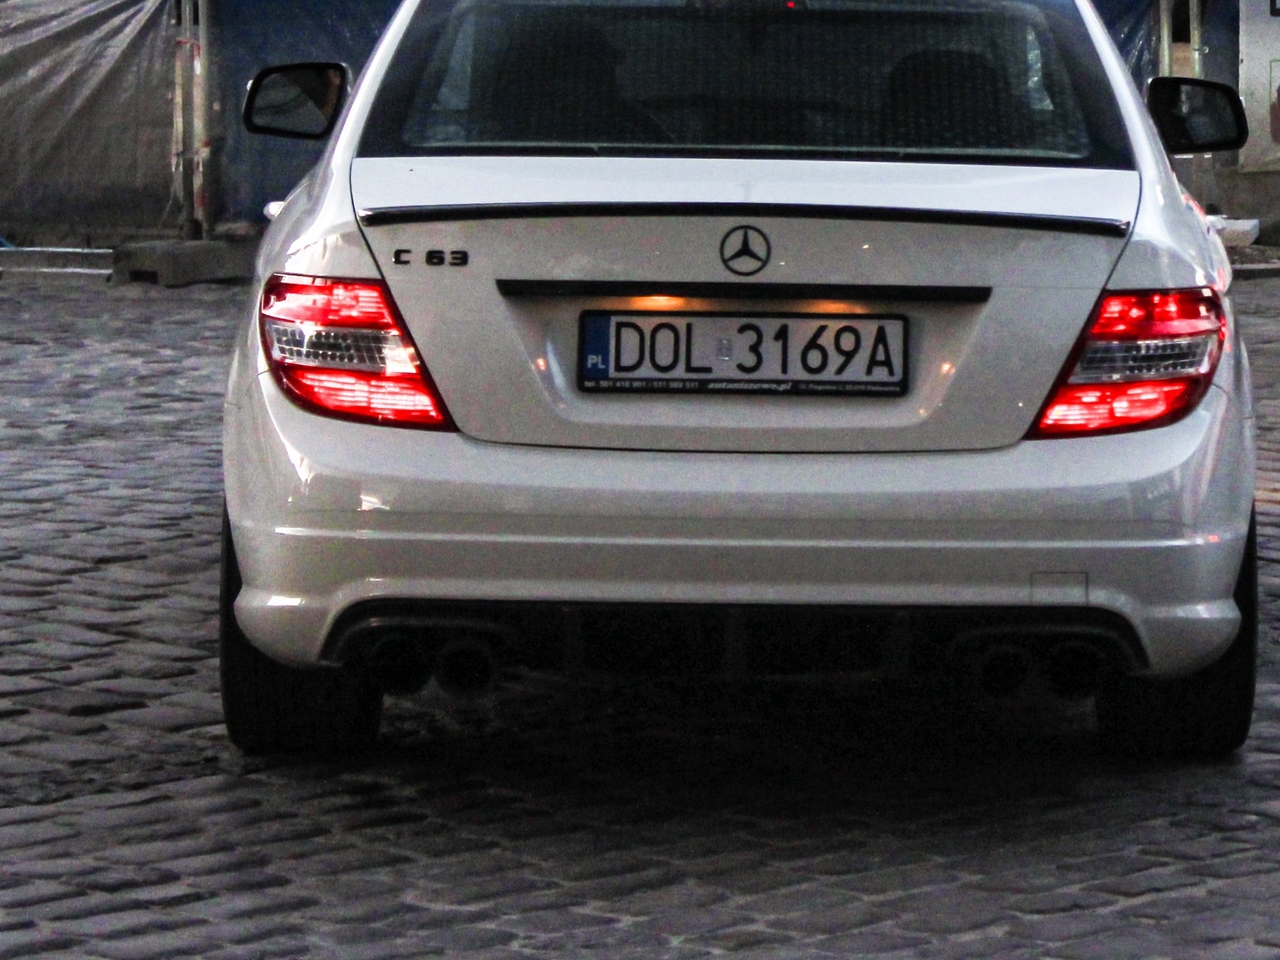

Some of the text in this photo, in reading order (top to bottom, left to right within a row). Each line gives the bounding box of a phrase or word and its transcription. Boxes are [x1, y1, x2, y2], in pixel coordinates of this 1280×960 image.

[393, 248, 469, 267] C 63
[614, 321, 896, 377] DOL 3169A
[586, 355, 606, 370] PL
